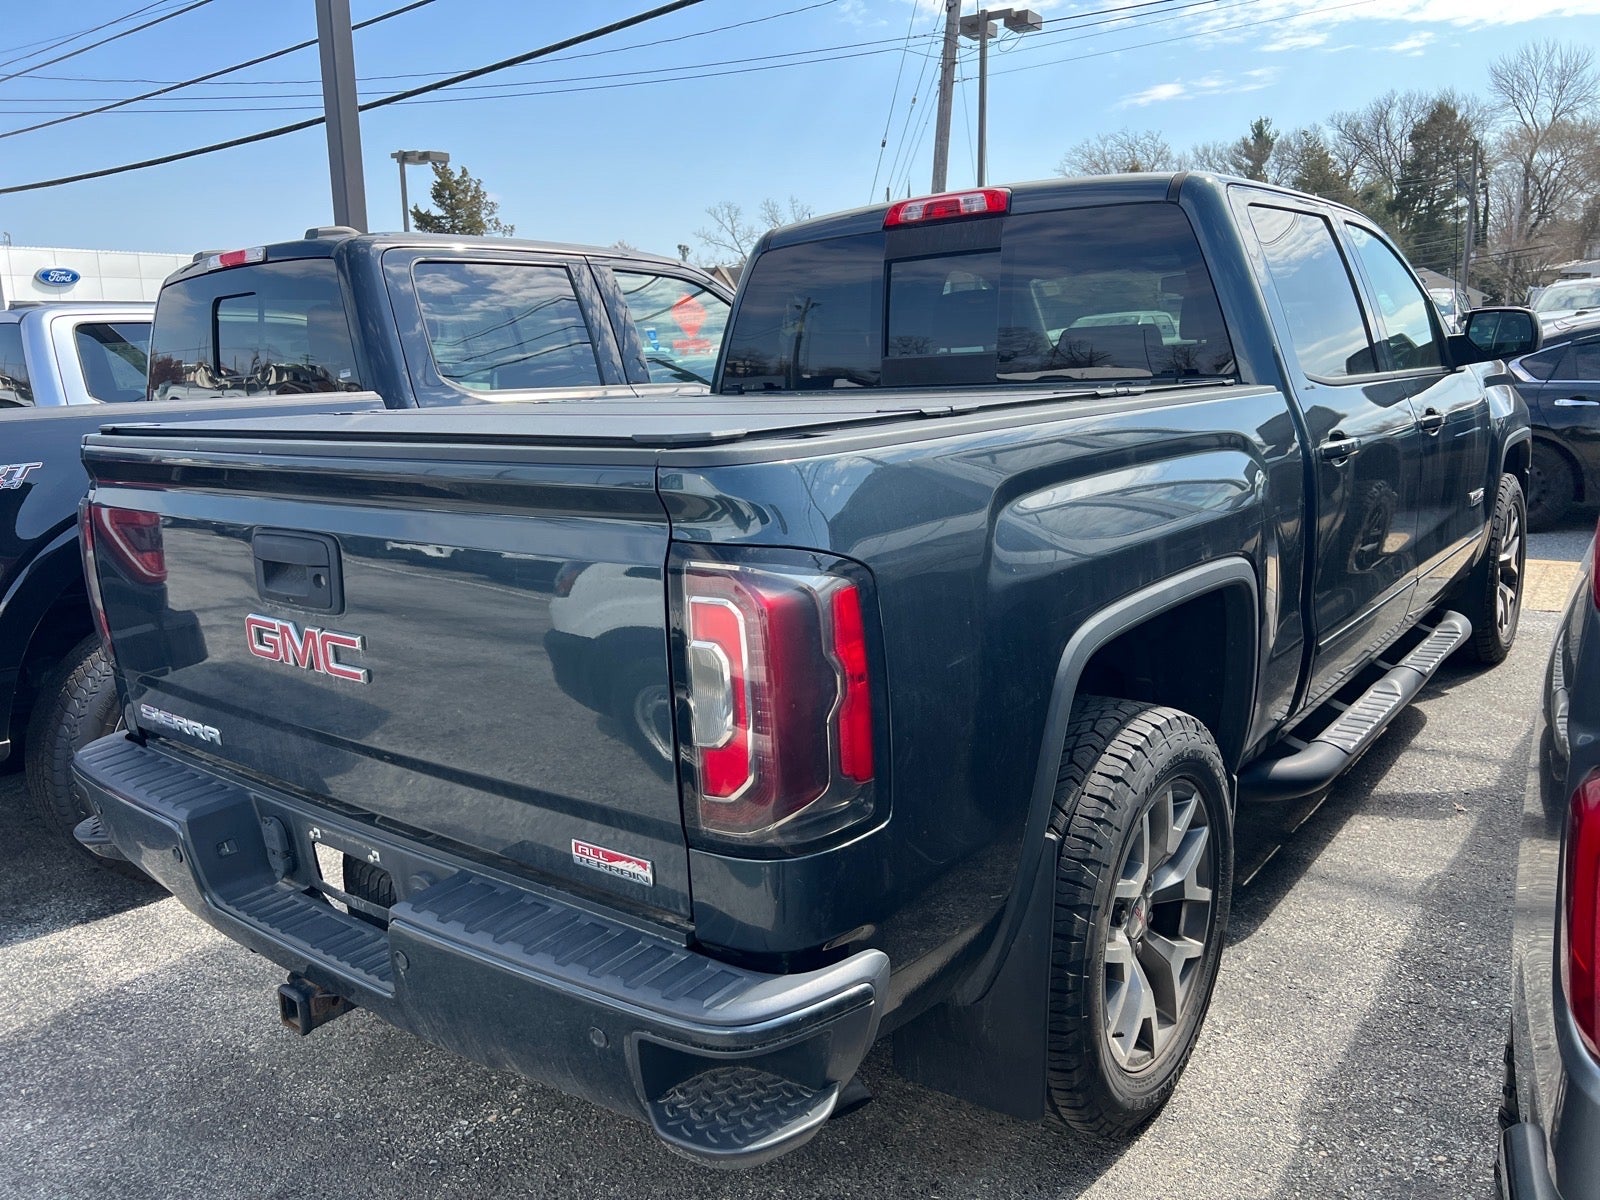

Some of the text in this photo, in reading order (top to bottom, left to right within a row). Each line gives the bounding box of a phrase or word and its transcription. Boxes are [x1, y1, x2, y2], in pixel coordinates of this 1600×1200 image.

[48, 270, 73, 282] Ford
[245, 613, 369, 684] GMC
[140, 704, 223, 746] SIERRA
[578, 845, 609, 862] ALL
[575, 855, 649, 884] TERRAIN
